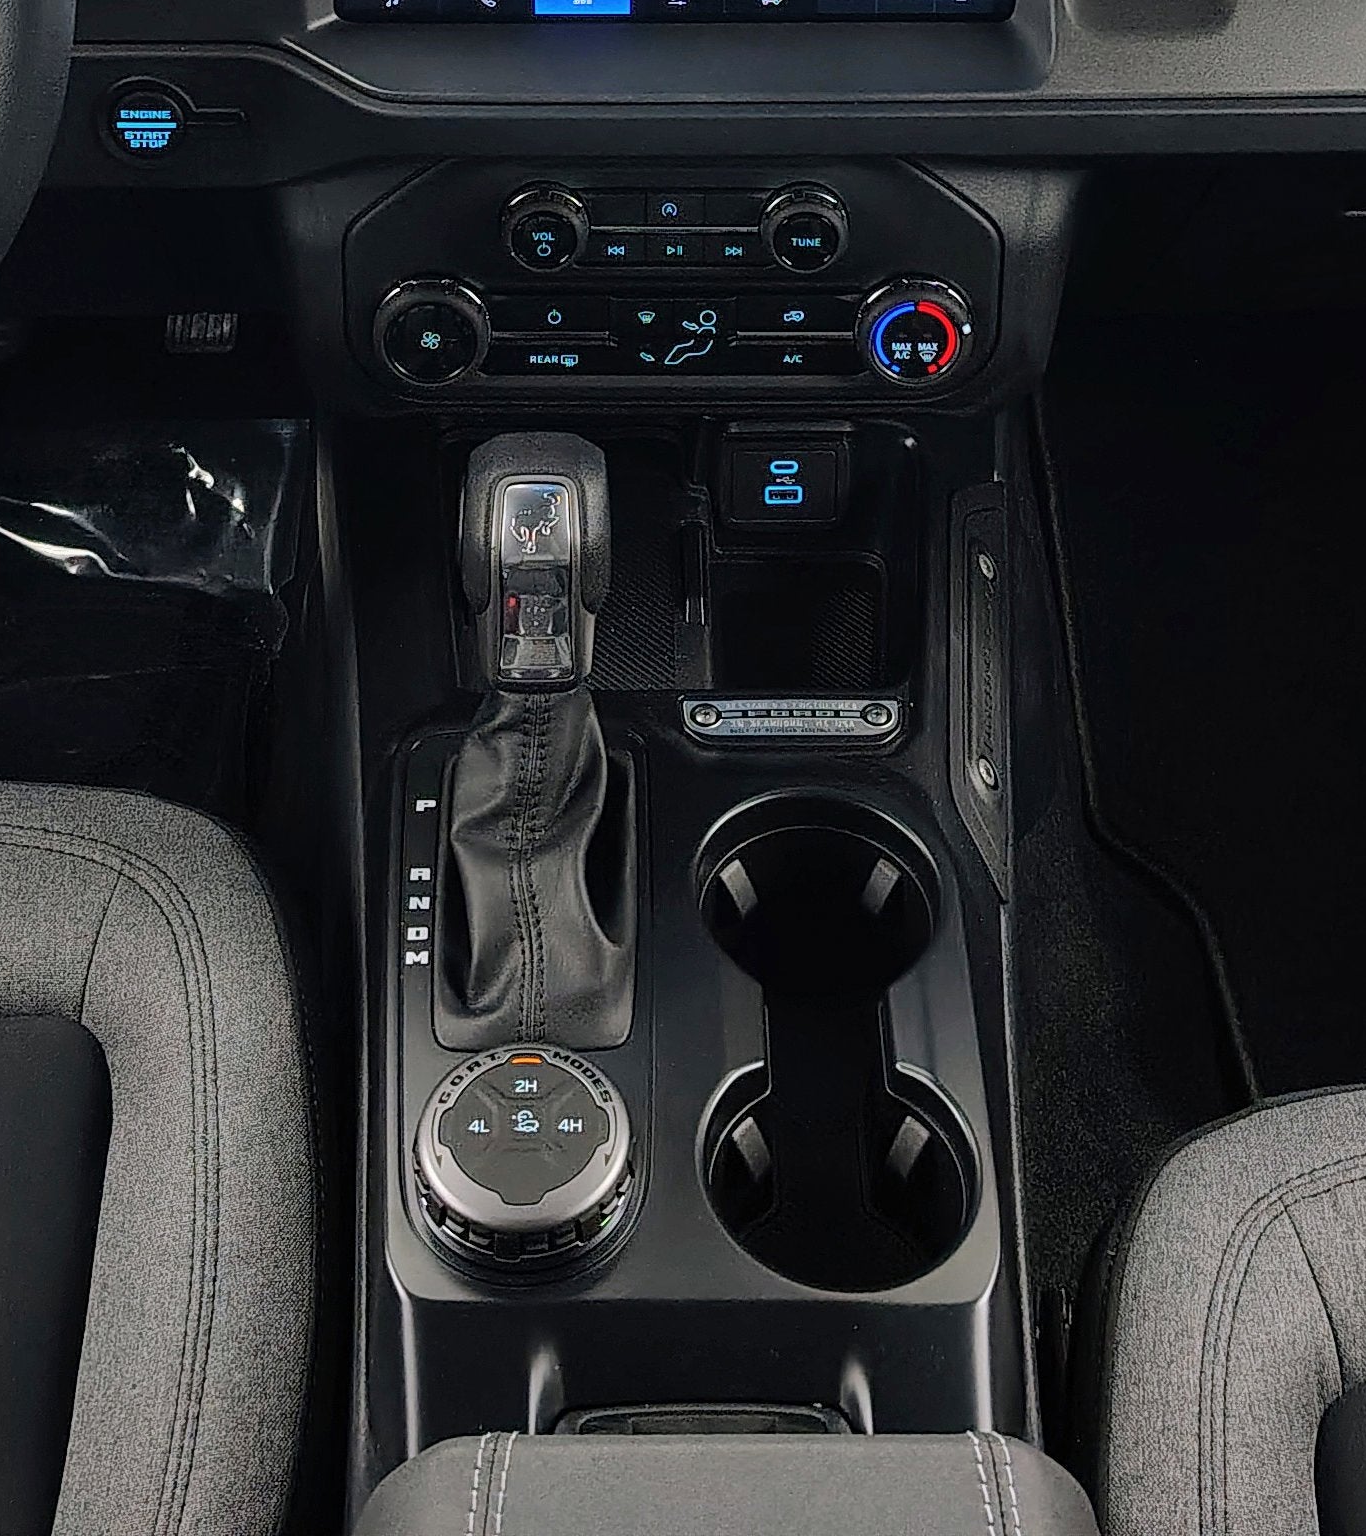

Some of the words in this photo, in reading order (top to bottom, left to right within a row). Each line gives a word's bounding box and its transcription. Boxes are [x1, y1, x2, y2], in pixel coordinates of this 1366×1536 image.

[119, 109, 172, 120] ENGINE
[124, 131, 172, 140] START
[130, 140, 168, 149] STOP
[532, 232, 555, 242] VOL
[790, 237, 822, 248] TUNE
[891, 342, 912, 351] MAX
[917, 342, 939, 351] MAX
[529, 355, 559, 364] REAR
[783, 354, 803, 364] A/C
[894, 350, 911, 360] A/C
[415, 799, 437, 812] P
[408, 896, 431, 910] N
[406, 926, 429, 941] D
[405, 950, 429, 965] M
[552, 1050, 614, 1104] MODES
[514, 1079, 538, 1093] 2H
[468, 1119, 491, 1134] 4L
[557, 1119, 583, 1134] 4H
